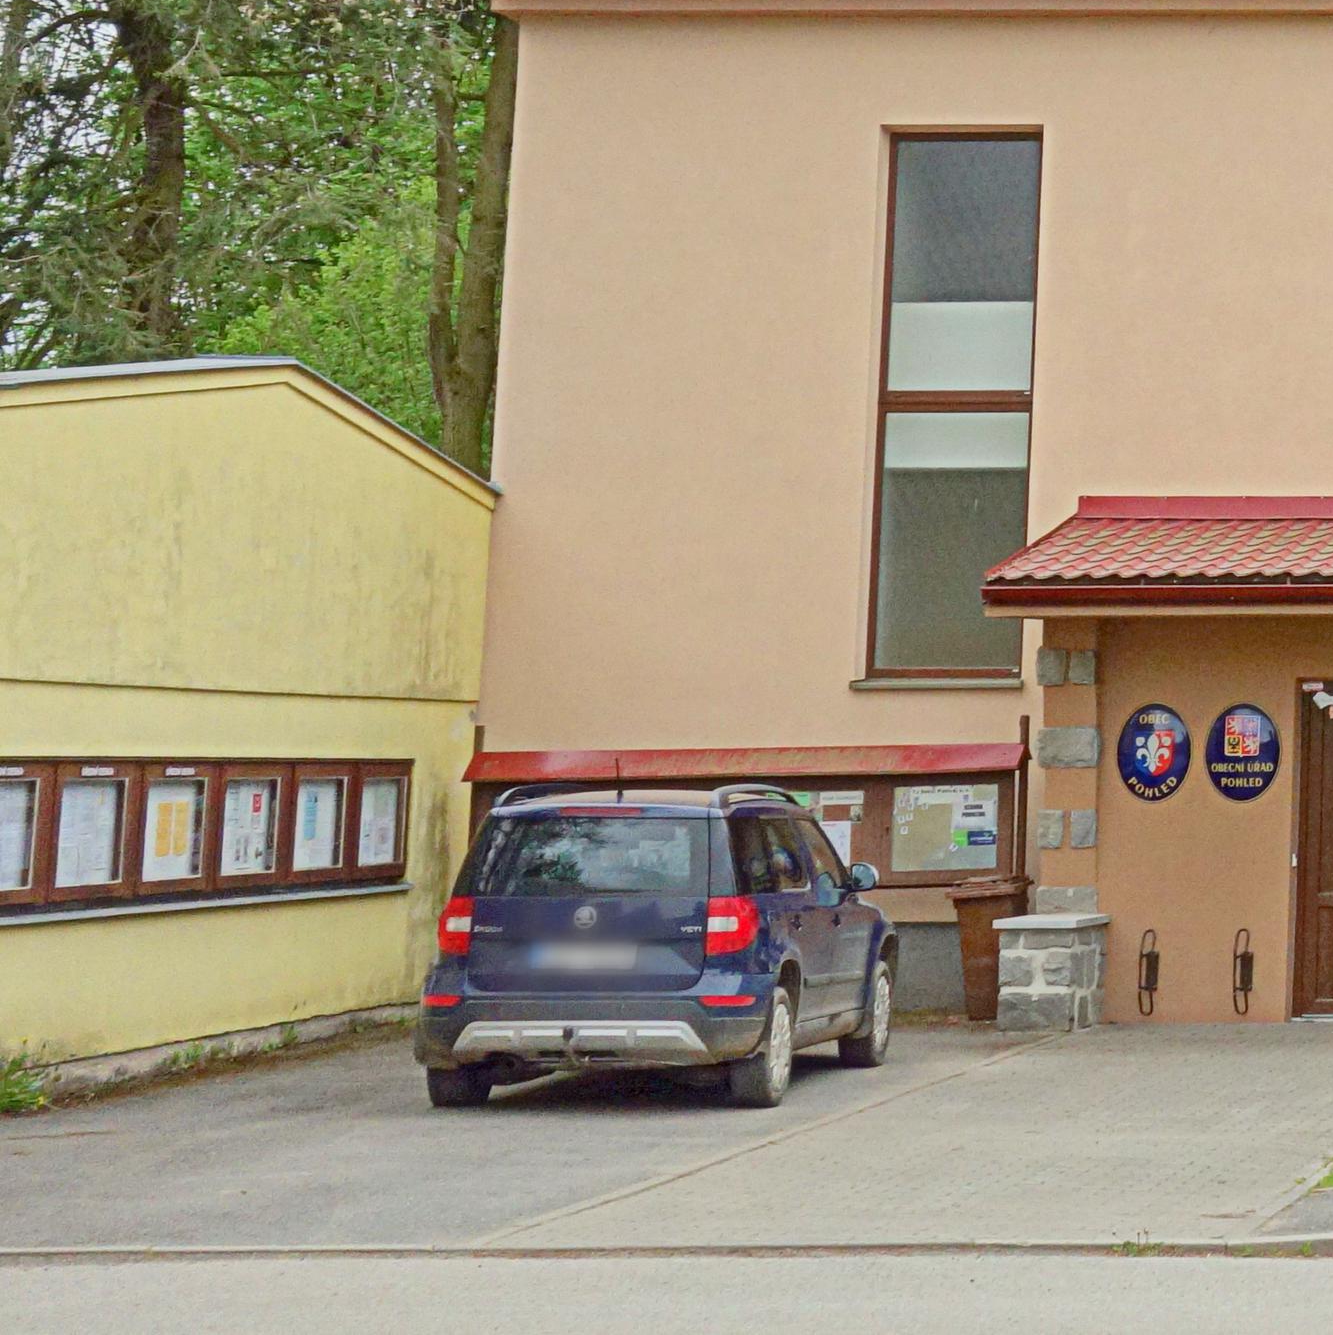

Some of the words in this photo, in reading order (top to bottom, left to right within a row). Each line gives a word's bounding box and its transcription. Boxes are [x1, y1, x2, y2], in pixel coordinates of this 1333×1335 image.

[1139, 714, 1170, 725] OBEC
[1211, 761, 1245, 772] OBECNÍ
[1128, 776, 1177, 798] POHLED
[1221, 777, 1263, 787] POHLED
